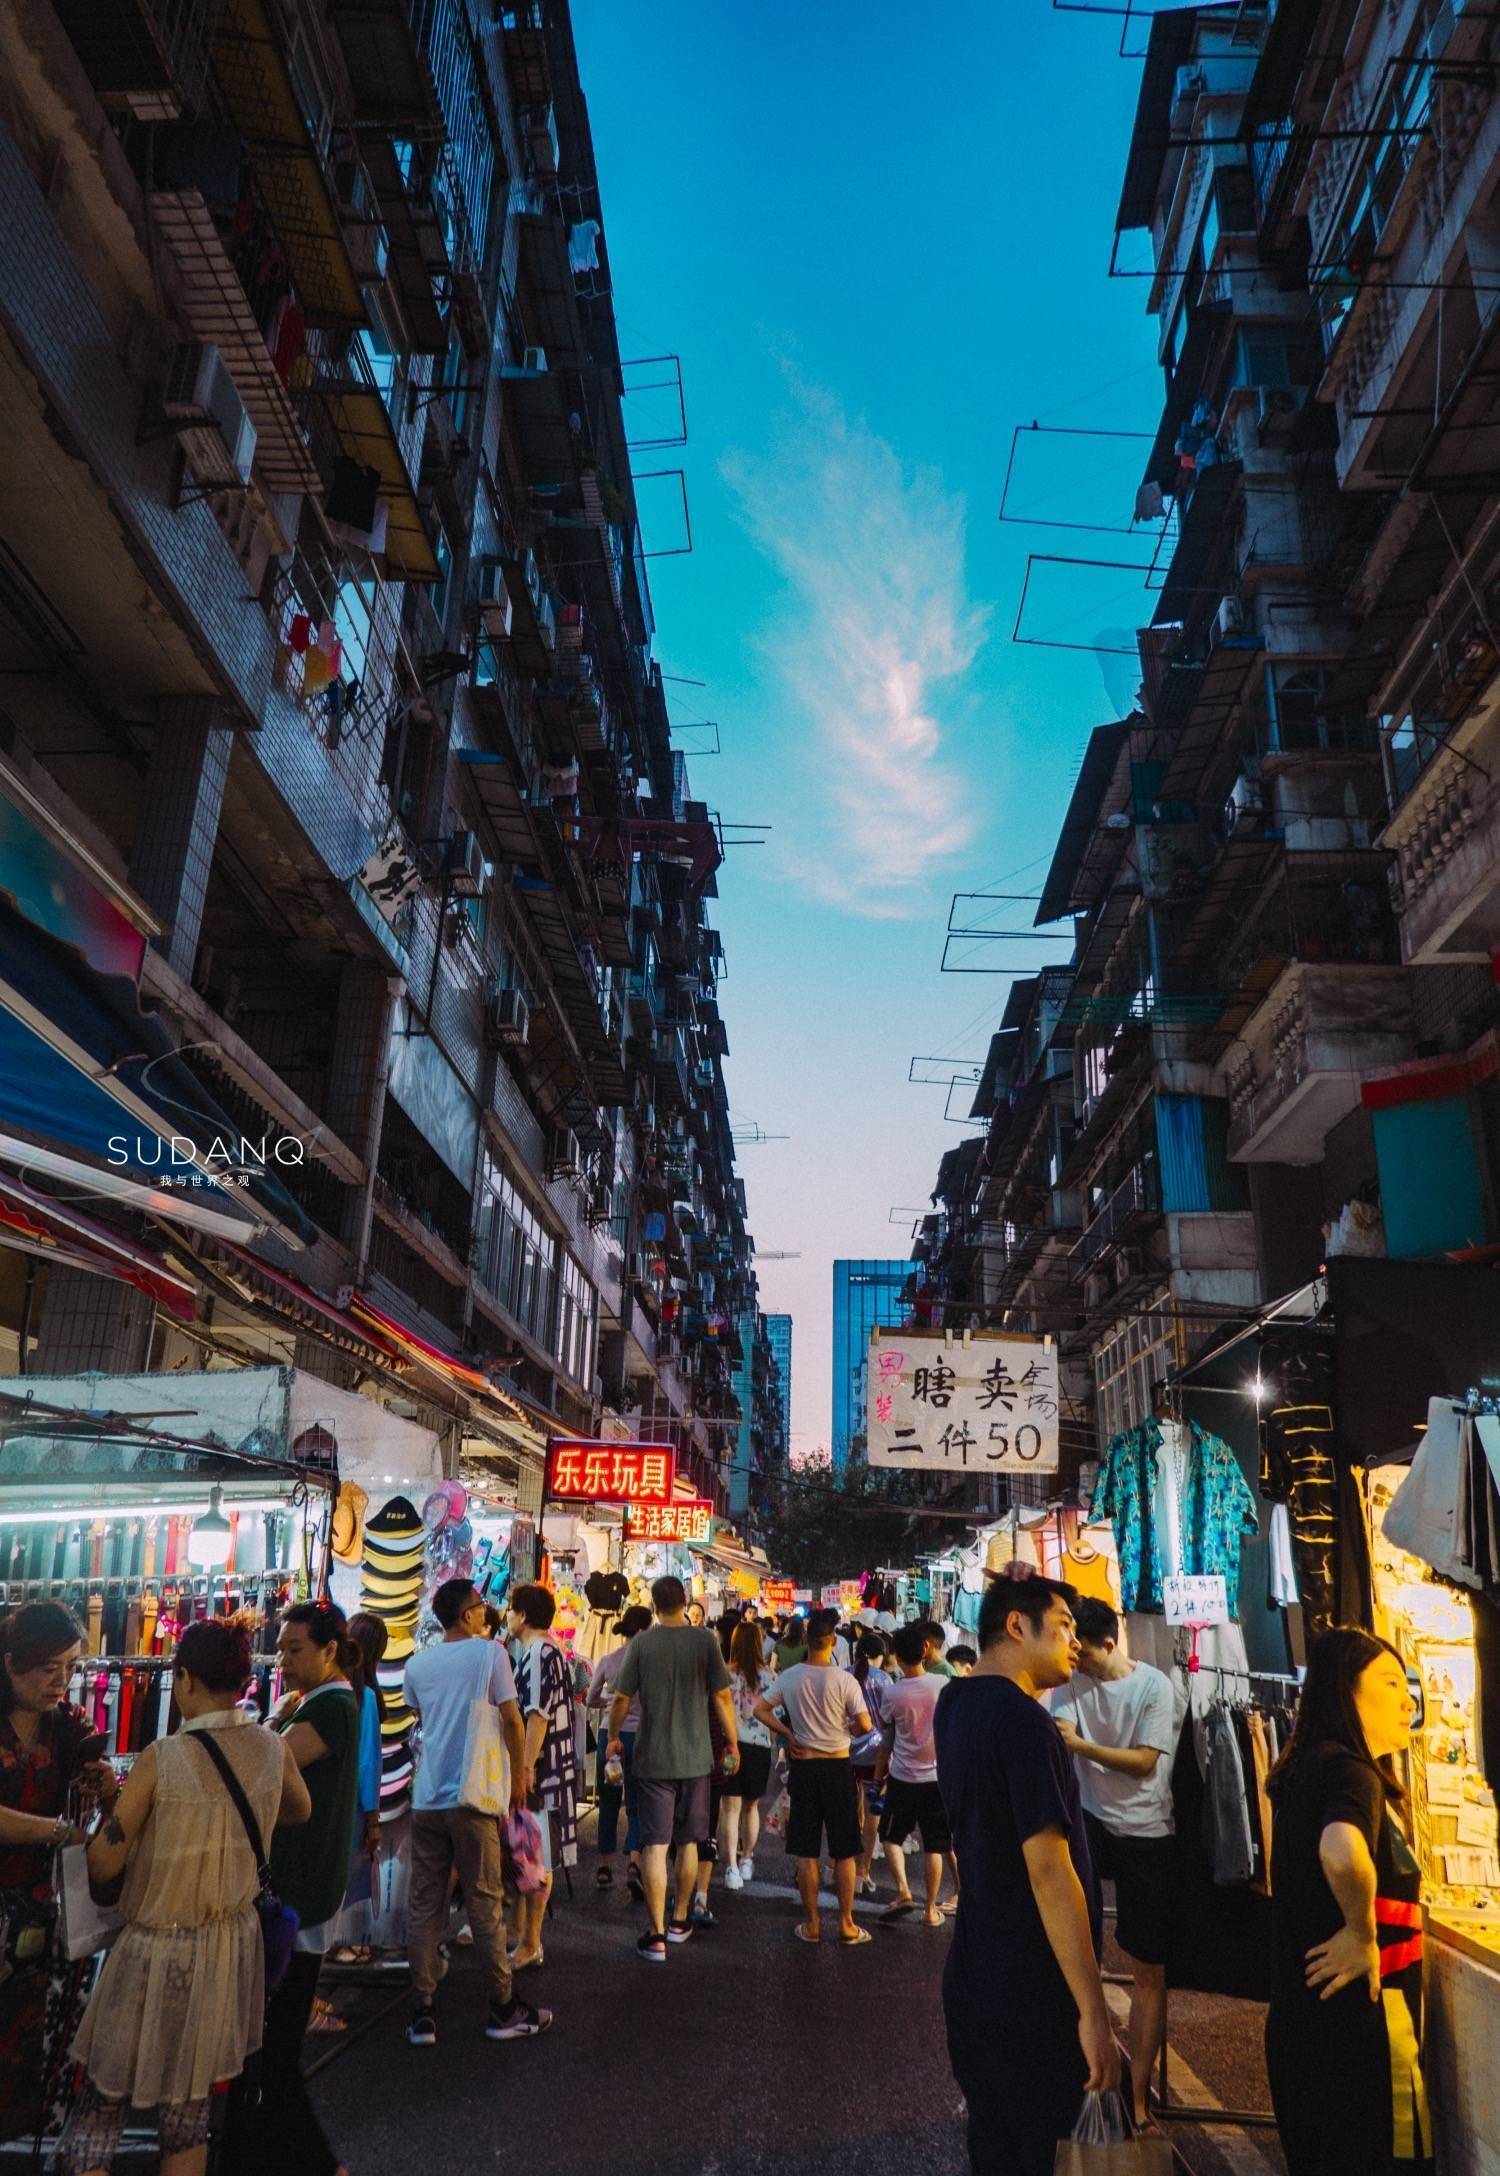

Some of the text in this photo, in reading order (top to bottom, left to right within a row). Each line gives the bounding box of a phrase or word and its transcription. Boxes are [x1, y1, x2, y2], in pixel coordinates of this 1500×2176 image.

[875, 1351, 904, 1424] 男装
[911, 1355, 1019, 1412] 瞎卖
[887, 1419, 1042, 1465] 二件50
[554, 1450, 667, 1498] 乐乐玩具
[630, 1504, 709, 1539] 生活家居馆
